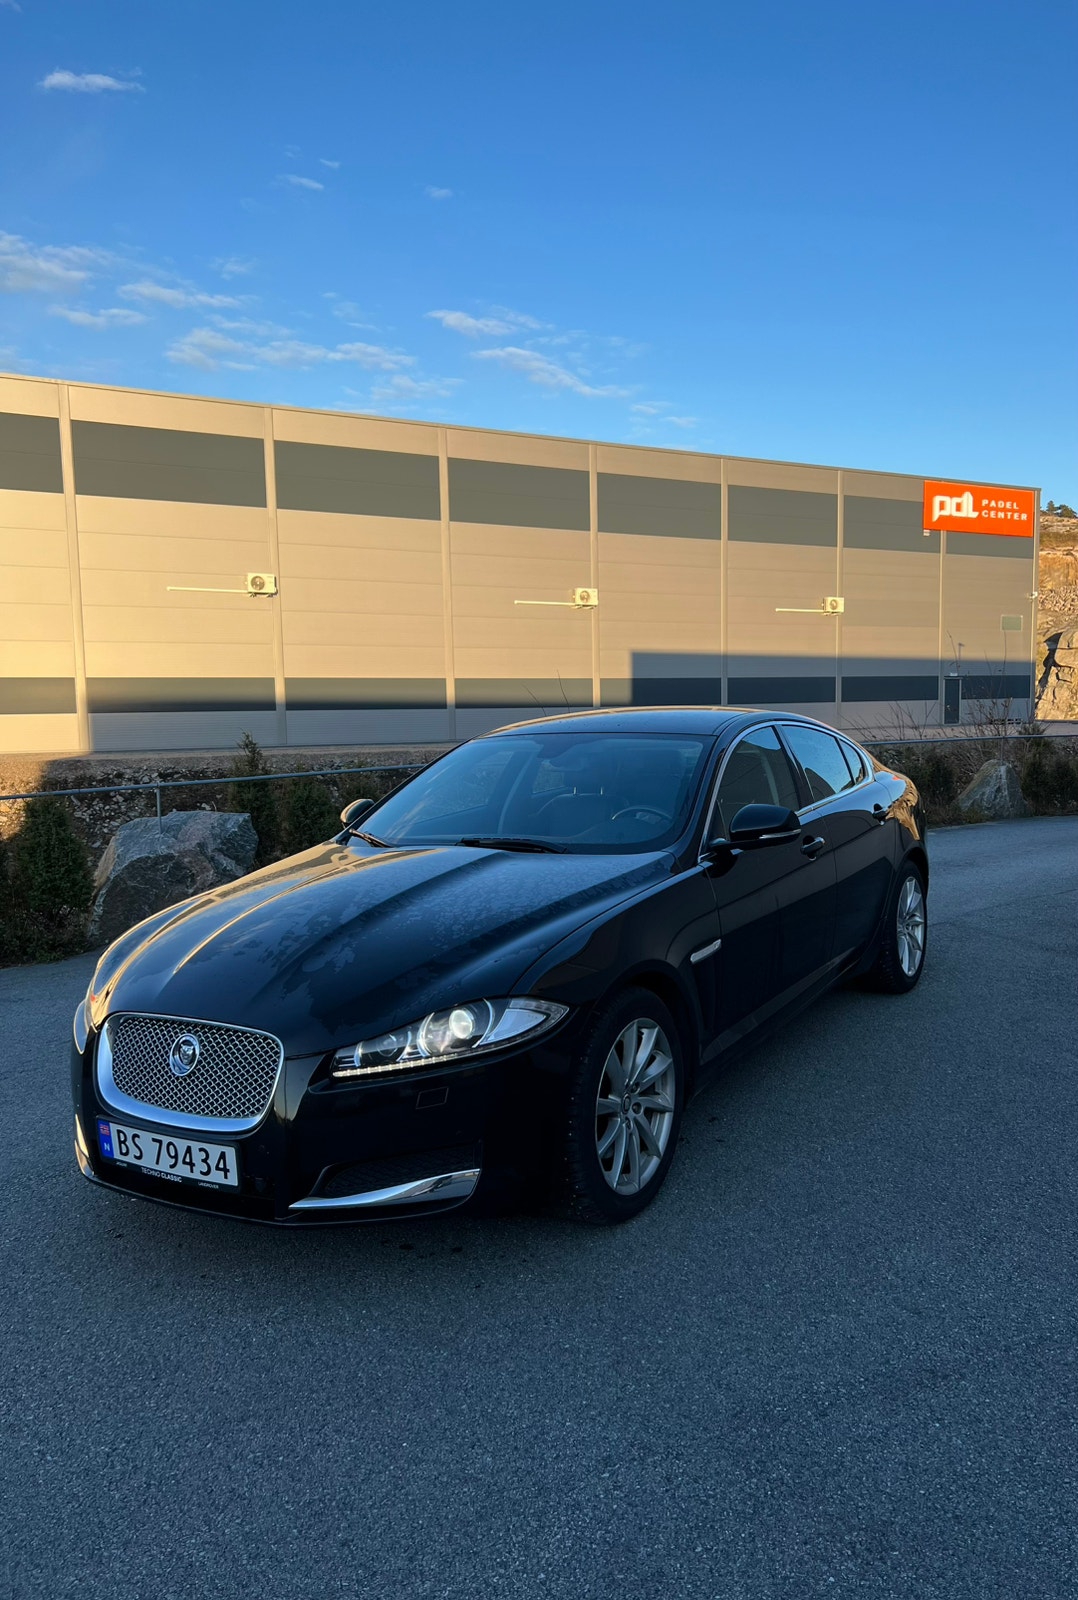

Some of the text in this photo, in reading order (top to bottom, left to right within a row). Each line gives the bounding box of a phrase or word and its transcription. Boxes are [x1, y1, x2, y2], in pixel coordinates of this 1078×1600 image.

[981, 499, 1019, 510] PADEL
[981, 510, 1028, 521] CENTER
[104, 1142, 110, 1151] N
[116, 1129, 230, 1180] BS 79434
[161, 1172, 182, 1183] CLASSIC
